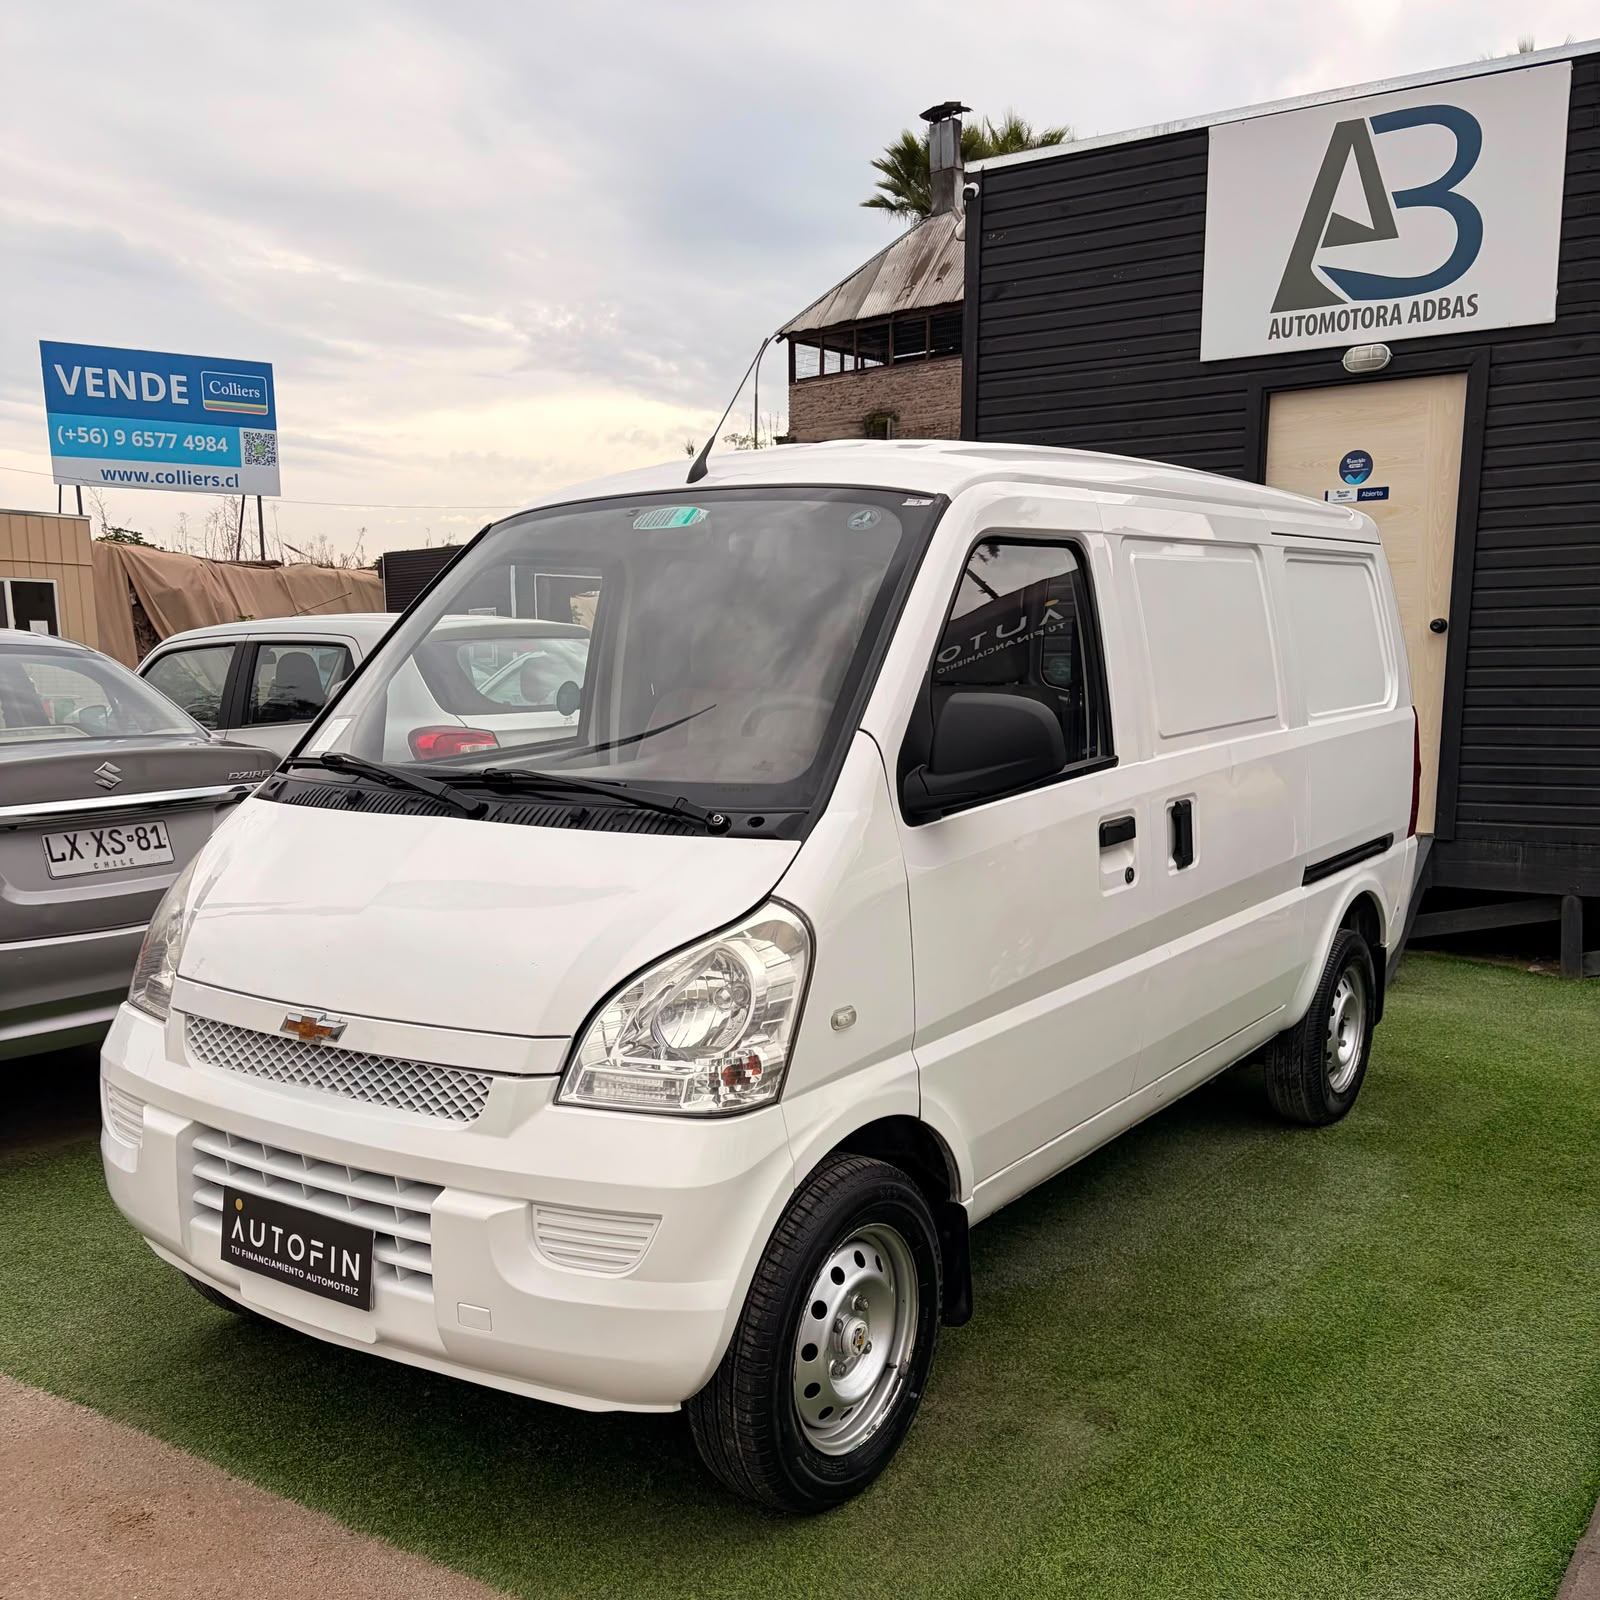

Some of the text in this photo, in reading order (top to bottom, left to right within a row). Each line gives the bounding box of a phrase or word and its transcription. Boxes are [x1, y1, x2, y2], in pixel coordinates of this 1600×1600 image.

[1267, 293, 1479, 340] AUTOMOTORA ADBAS
[54, 364, 189, 405] VENDE
[209, 380, 260, 398] Colliers
[57, 425, 228, 453] (+56) 9 6577 4984
[101, 468, 239, 488] www.colliers.cl
[93, 857, 135, 870] CHILE
[231, 1214, 361, 1281] AUTOFIN
[231, 1245, 359, 1297] TU FINANCIAMIENTO AUTOMOTRIZ
